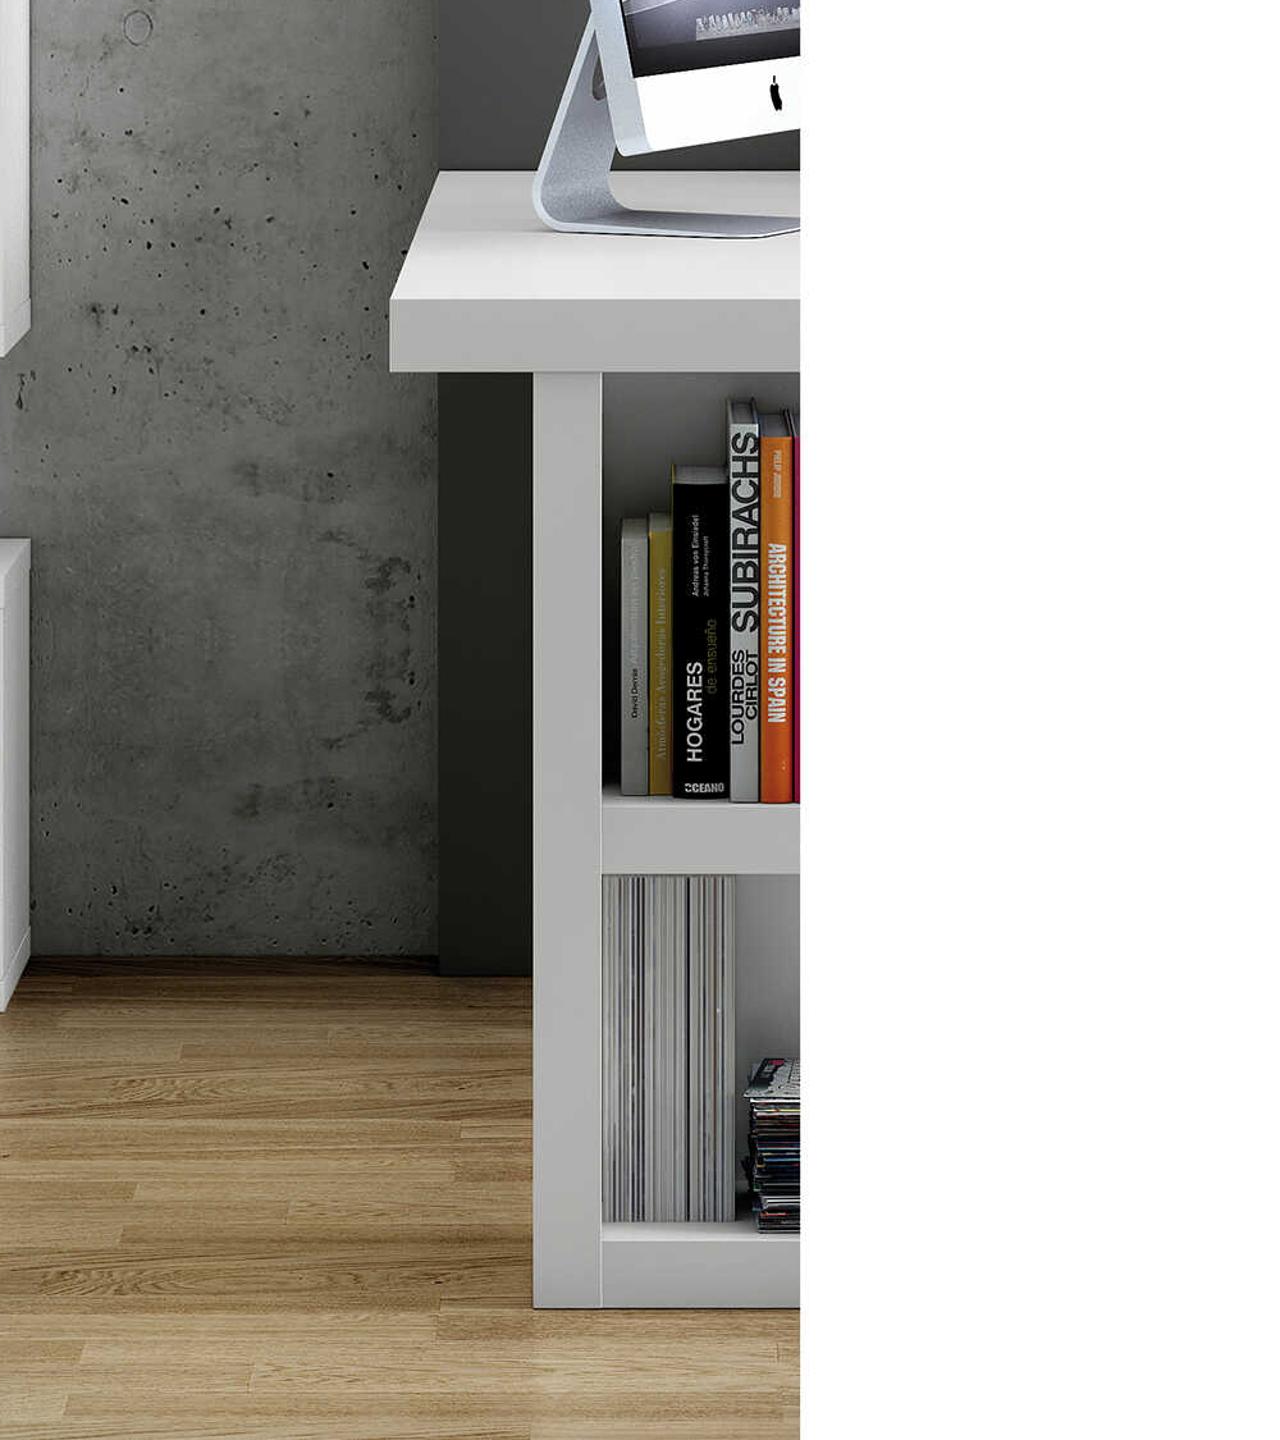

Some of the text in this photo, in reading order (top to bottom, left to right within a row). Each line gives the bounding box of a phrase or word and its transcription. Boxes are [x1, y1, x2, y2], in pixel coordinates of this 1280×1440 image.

[692, 549, 700, 565] von
[731, 431, 760, 634] SUBIRACHS
[691, 564, 700, 597] Andreas
[767, 542, 787, 725] ARCHITECTURE IN SPAIN
[631, 692, 639, 719] David
[686, 661, 704, 763] HOGARES
[731, 649, 746, 745] LOURDES
[744, 651, 759, 721] CIRLOT
[684, 782, 725, 794] OCEANO
